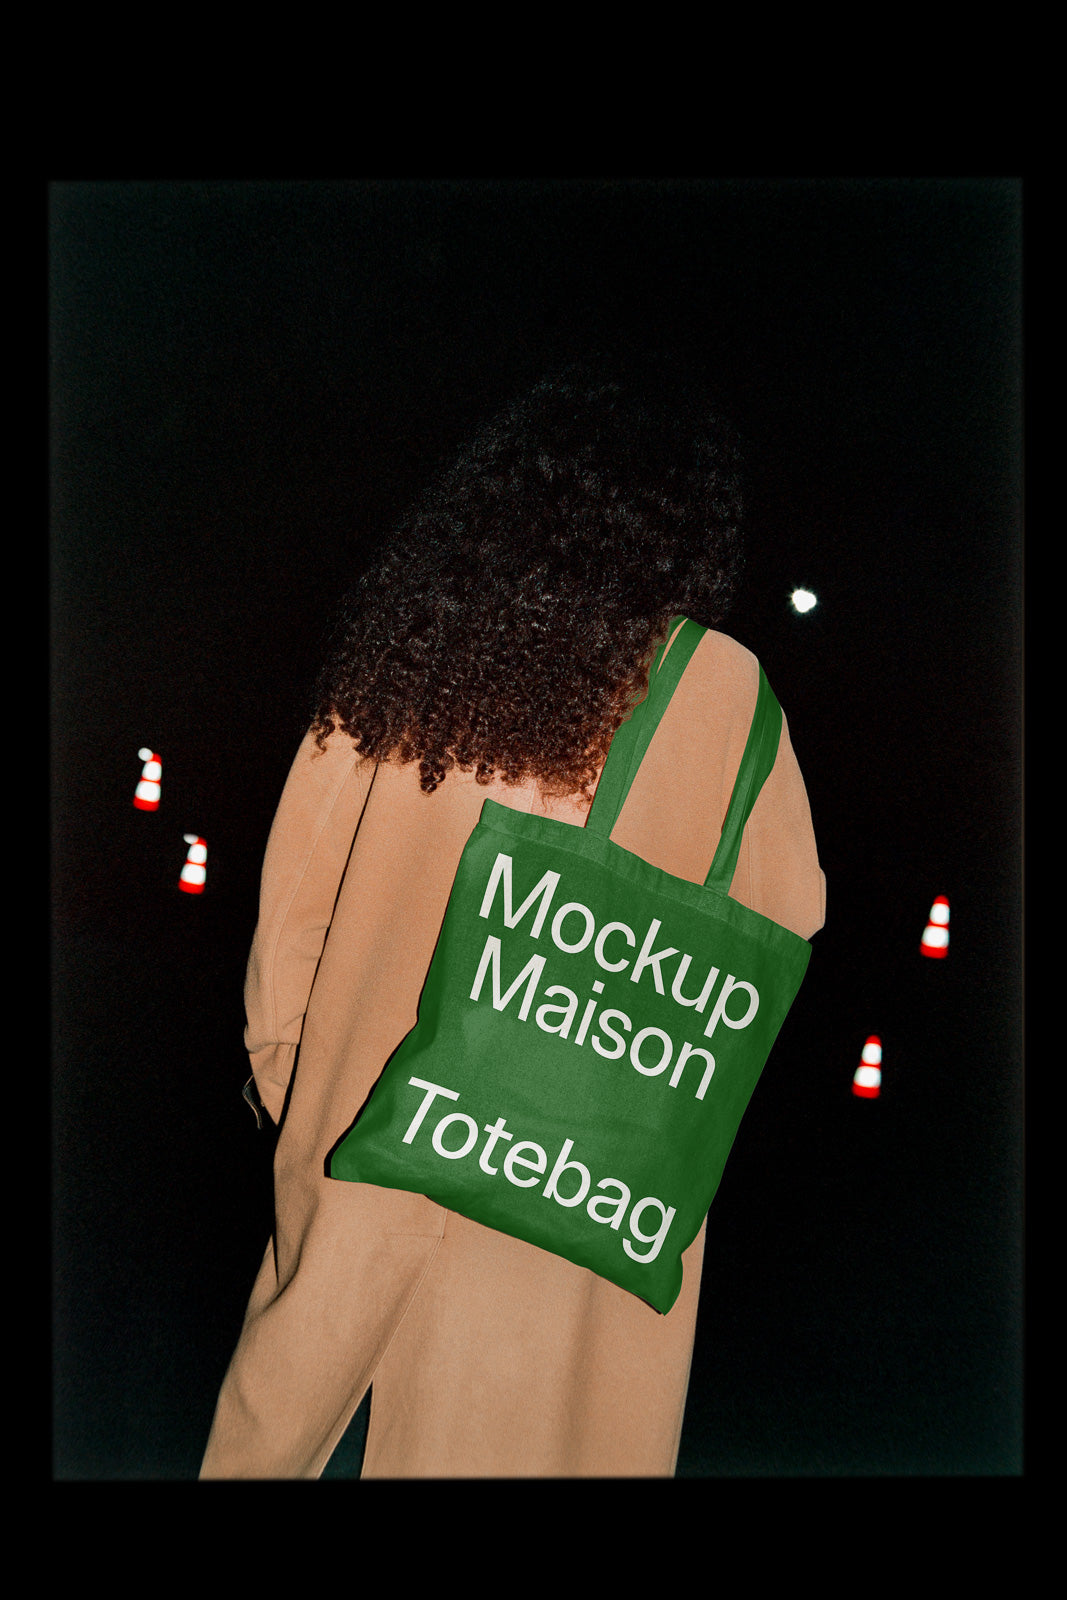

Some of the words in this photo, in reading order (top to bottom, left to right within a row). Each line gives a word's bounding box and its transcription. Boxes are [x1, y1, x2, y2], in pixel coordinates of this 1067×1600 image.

[469, 934, 716, 1101] Maison
[478, 852, 760, 1039] Mockup
[401, 1076, 677, 1264] Totebag
